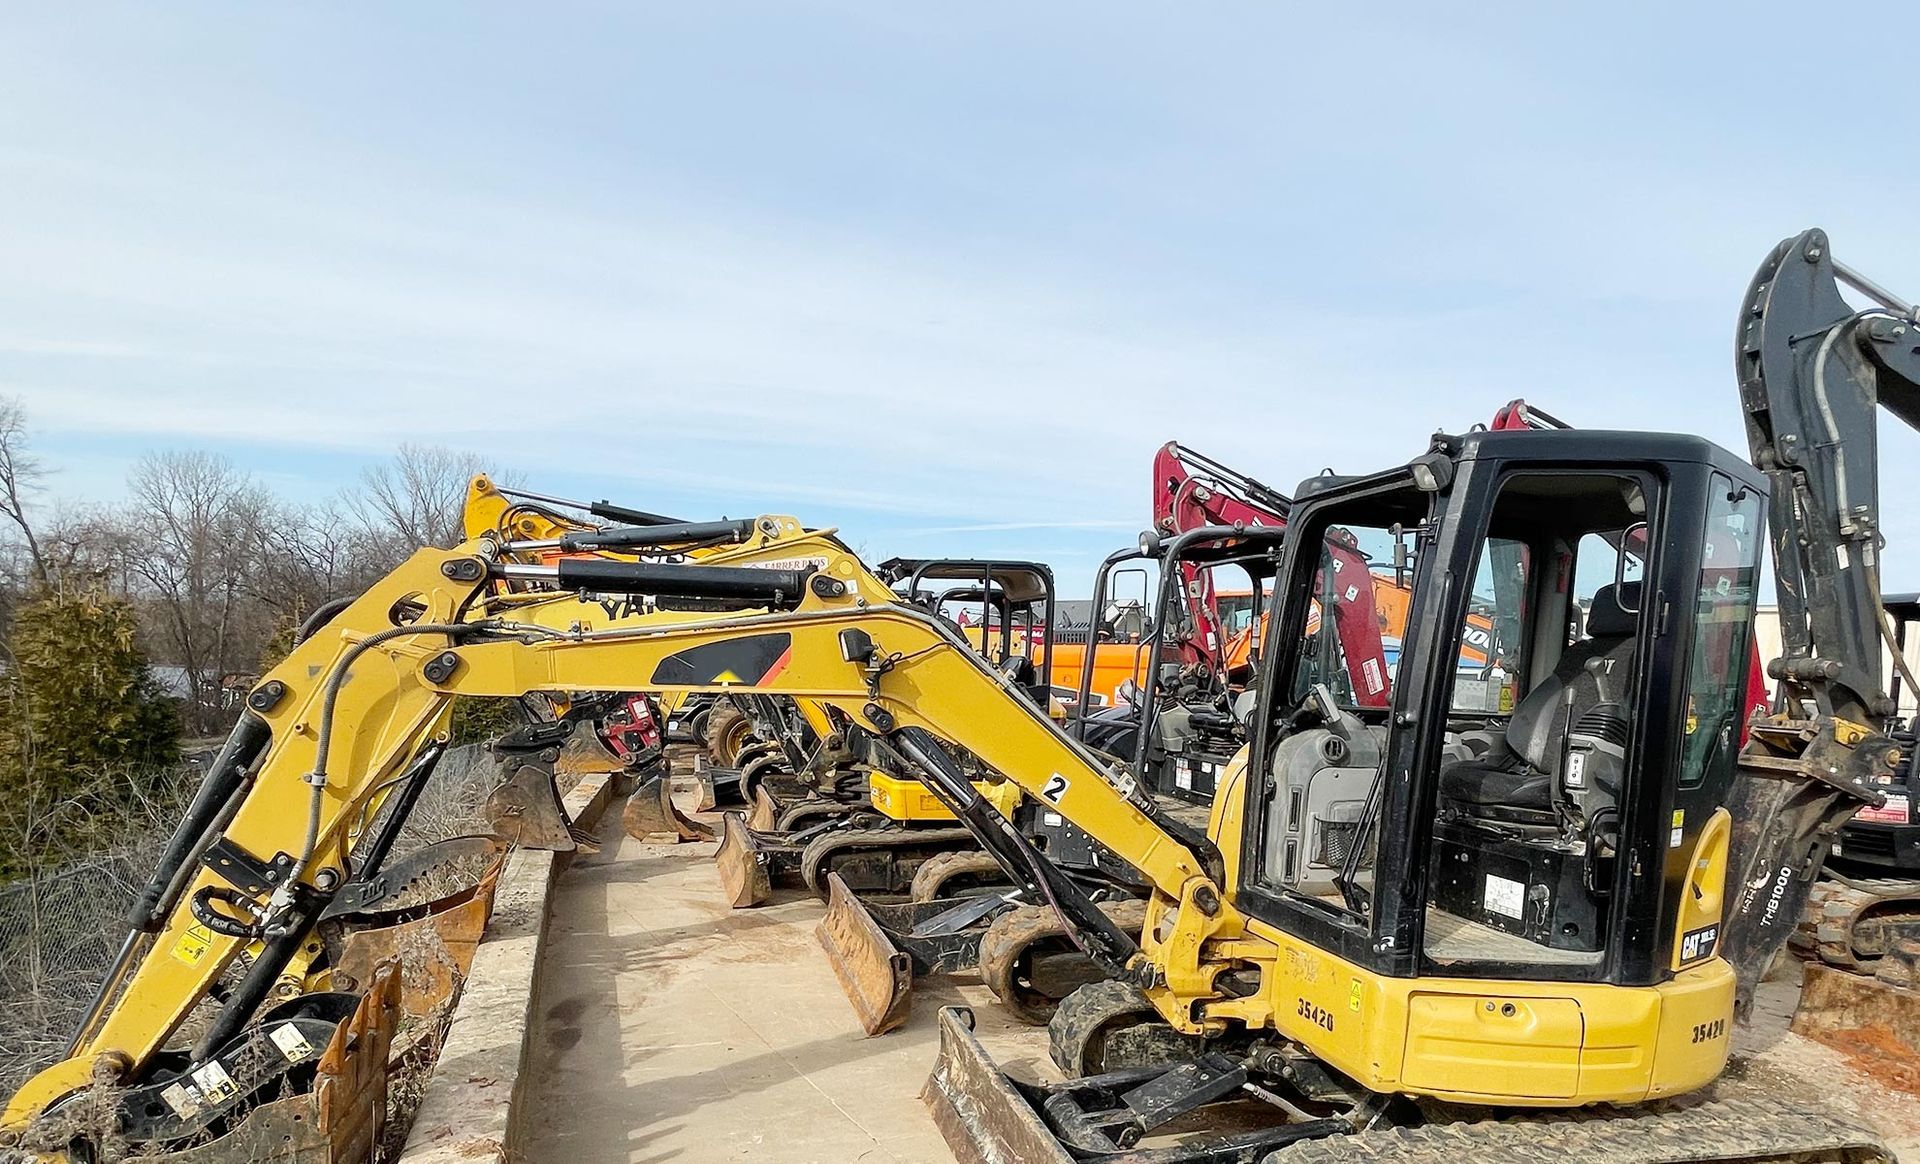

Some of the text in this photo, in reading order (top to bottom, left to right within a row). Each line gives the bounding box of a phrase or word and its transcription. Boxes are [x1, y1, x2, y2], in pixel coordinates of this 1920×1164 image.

[1043, 776, 1066, 802] 2
[1681, 933, 1701, 960] CAT
[1297, 997, 1333, 1032] 35420
[1692, 1018, 1725, 1044] 35420
